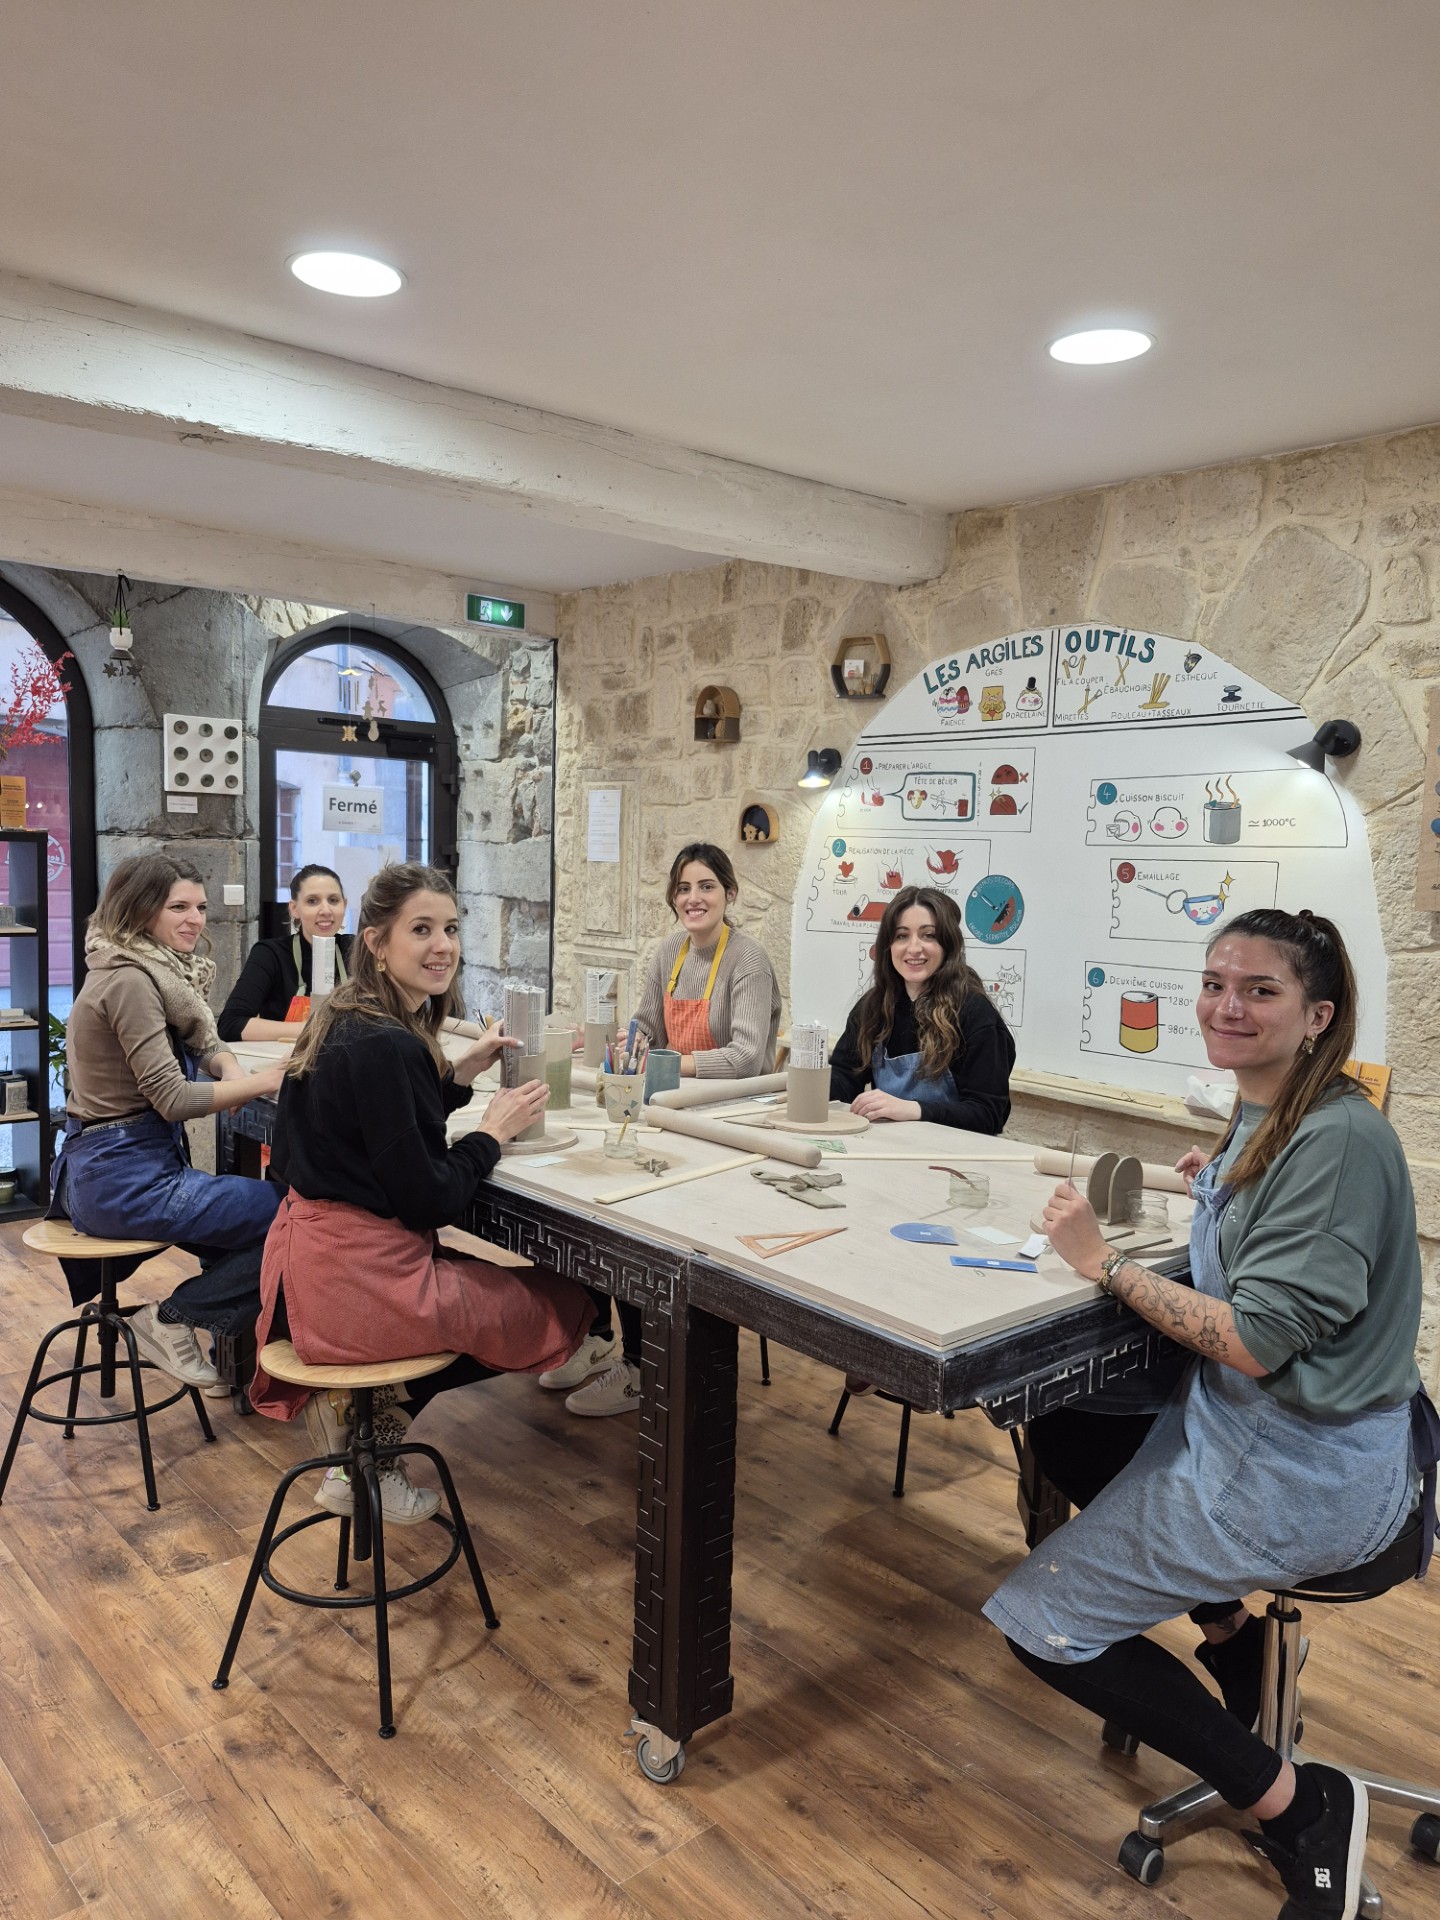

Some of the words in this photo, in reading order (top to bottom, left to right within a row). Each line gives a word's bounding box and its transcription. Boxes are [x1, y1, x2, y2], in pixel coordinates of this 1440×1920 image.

[923, 659, 961, 694] LES
[1216, 701, 1266, 712] TOURNETTE
[1005, 711, 1047, 720] PORCELAINE
[1152, 708, 1192, 717] TASSEAUX
[1119, 793, 1153, 803] CUISSON
[1155, 792, 1185, 802] BISCUIT
[329, 797, 378, 814] Fermé
[1149, 980, 1184, 990] CUISSON
